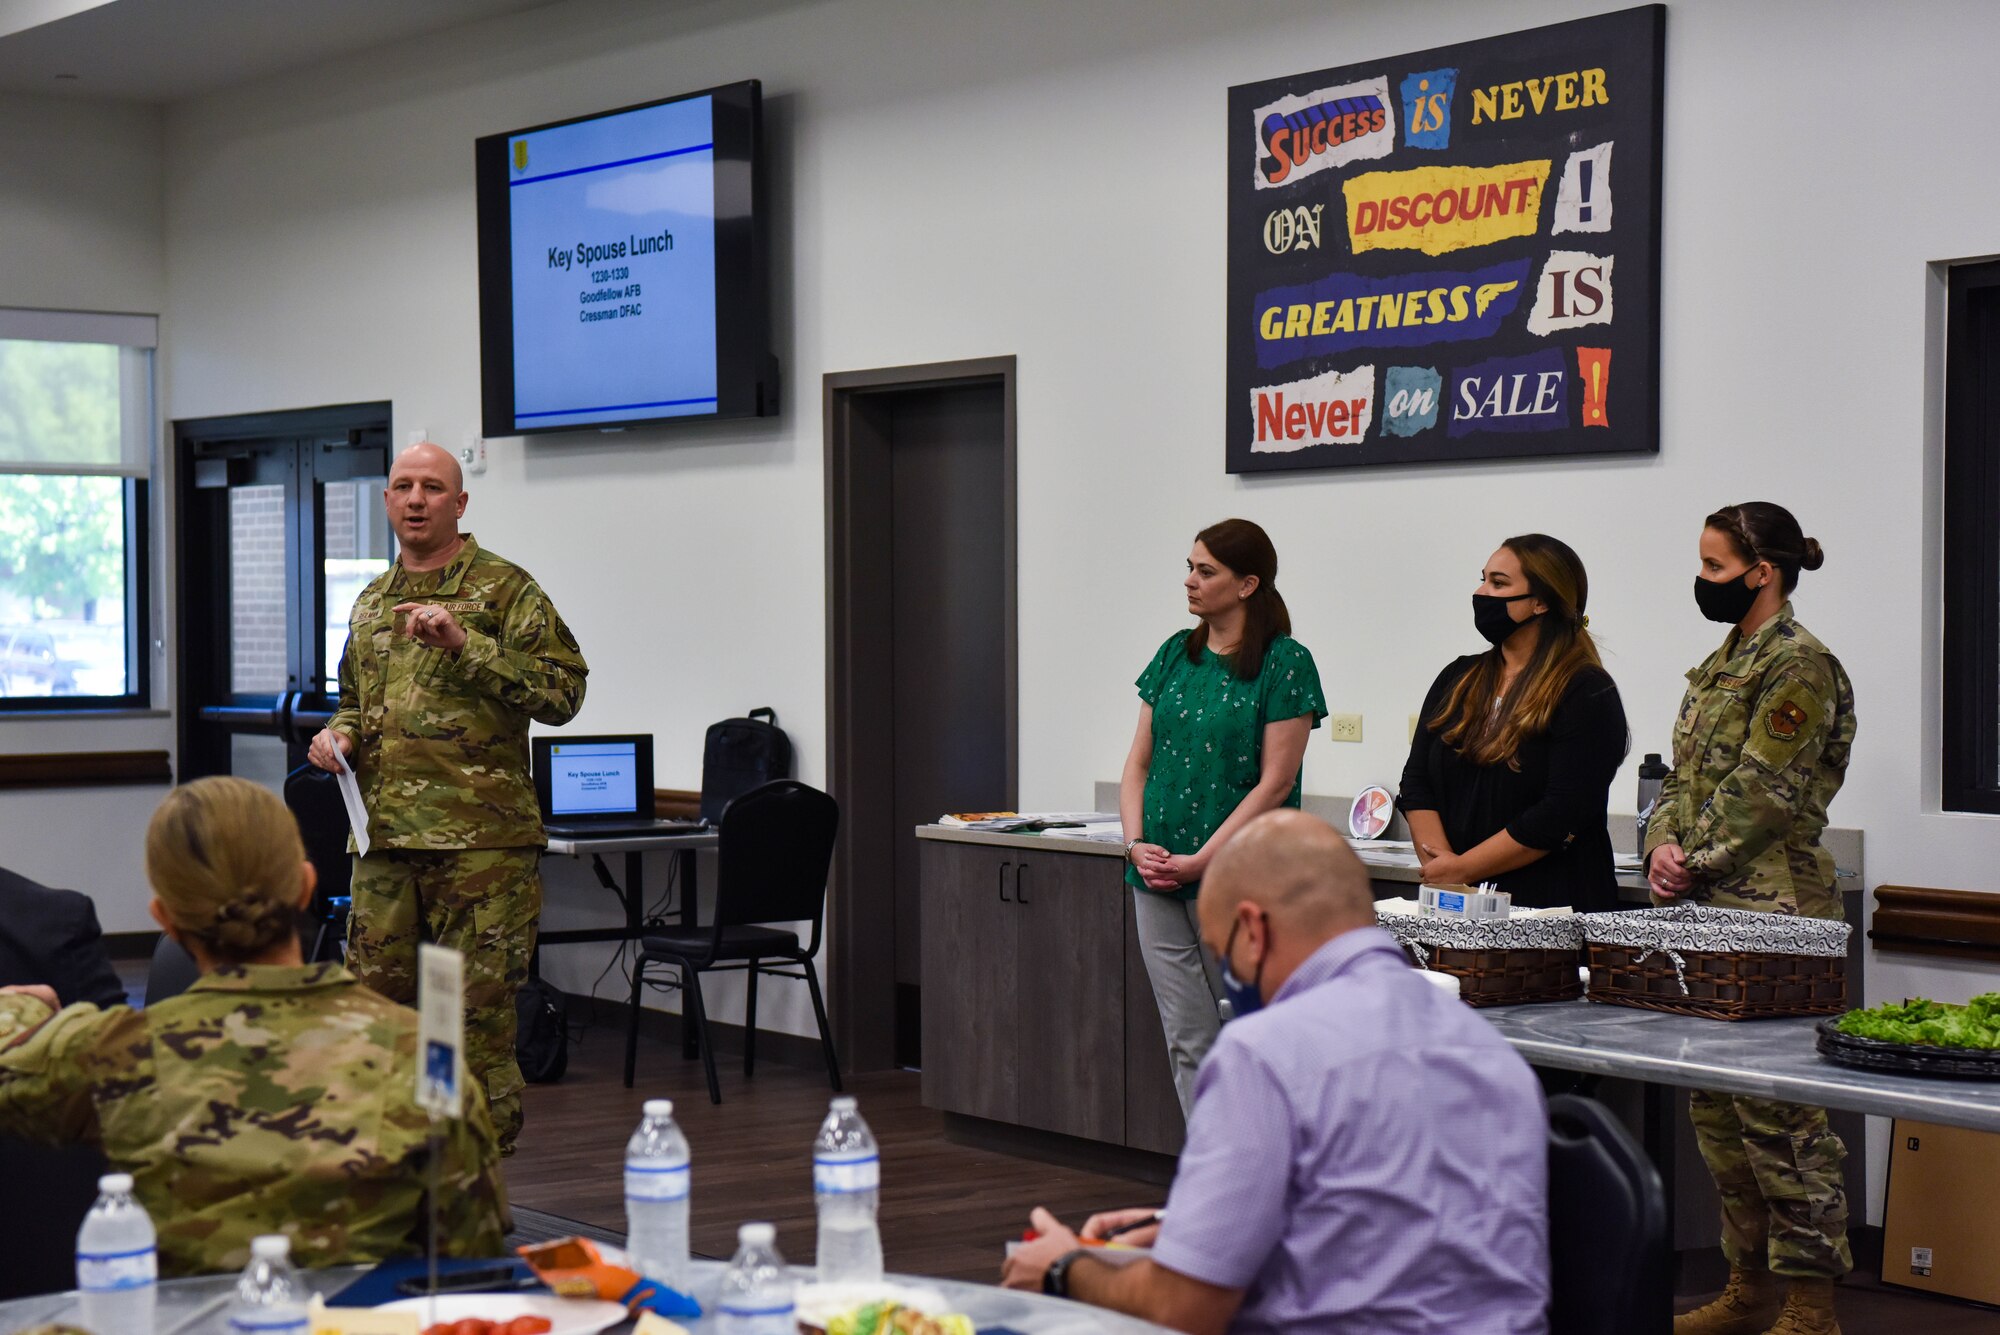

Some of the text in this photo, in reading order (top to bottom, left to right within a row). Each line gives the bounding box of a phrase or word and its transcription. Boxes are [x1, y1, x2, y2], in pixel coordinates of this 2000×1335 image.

[1262, 68, 1610, 183] SUCCESS is NEVER
[1263, 160, 1593, 254] ON DISCOUNT !
[548, 229, 673, 272] Key Spouse Lunch
[580, 284, 642, 304] Goodfellow AFB
[591, 266, 630, 283] 1230-1330
[580, 303, 642, 323] Cressman DFAC
[1259, 267, 1605, 340] GREATNESS IS
[1257, 360, 1601, 442] Never on SALE !
[444, 602, 457, 611] AIR
[457, 602, 482, 612] FORCE
